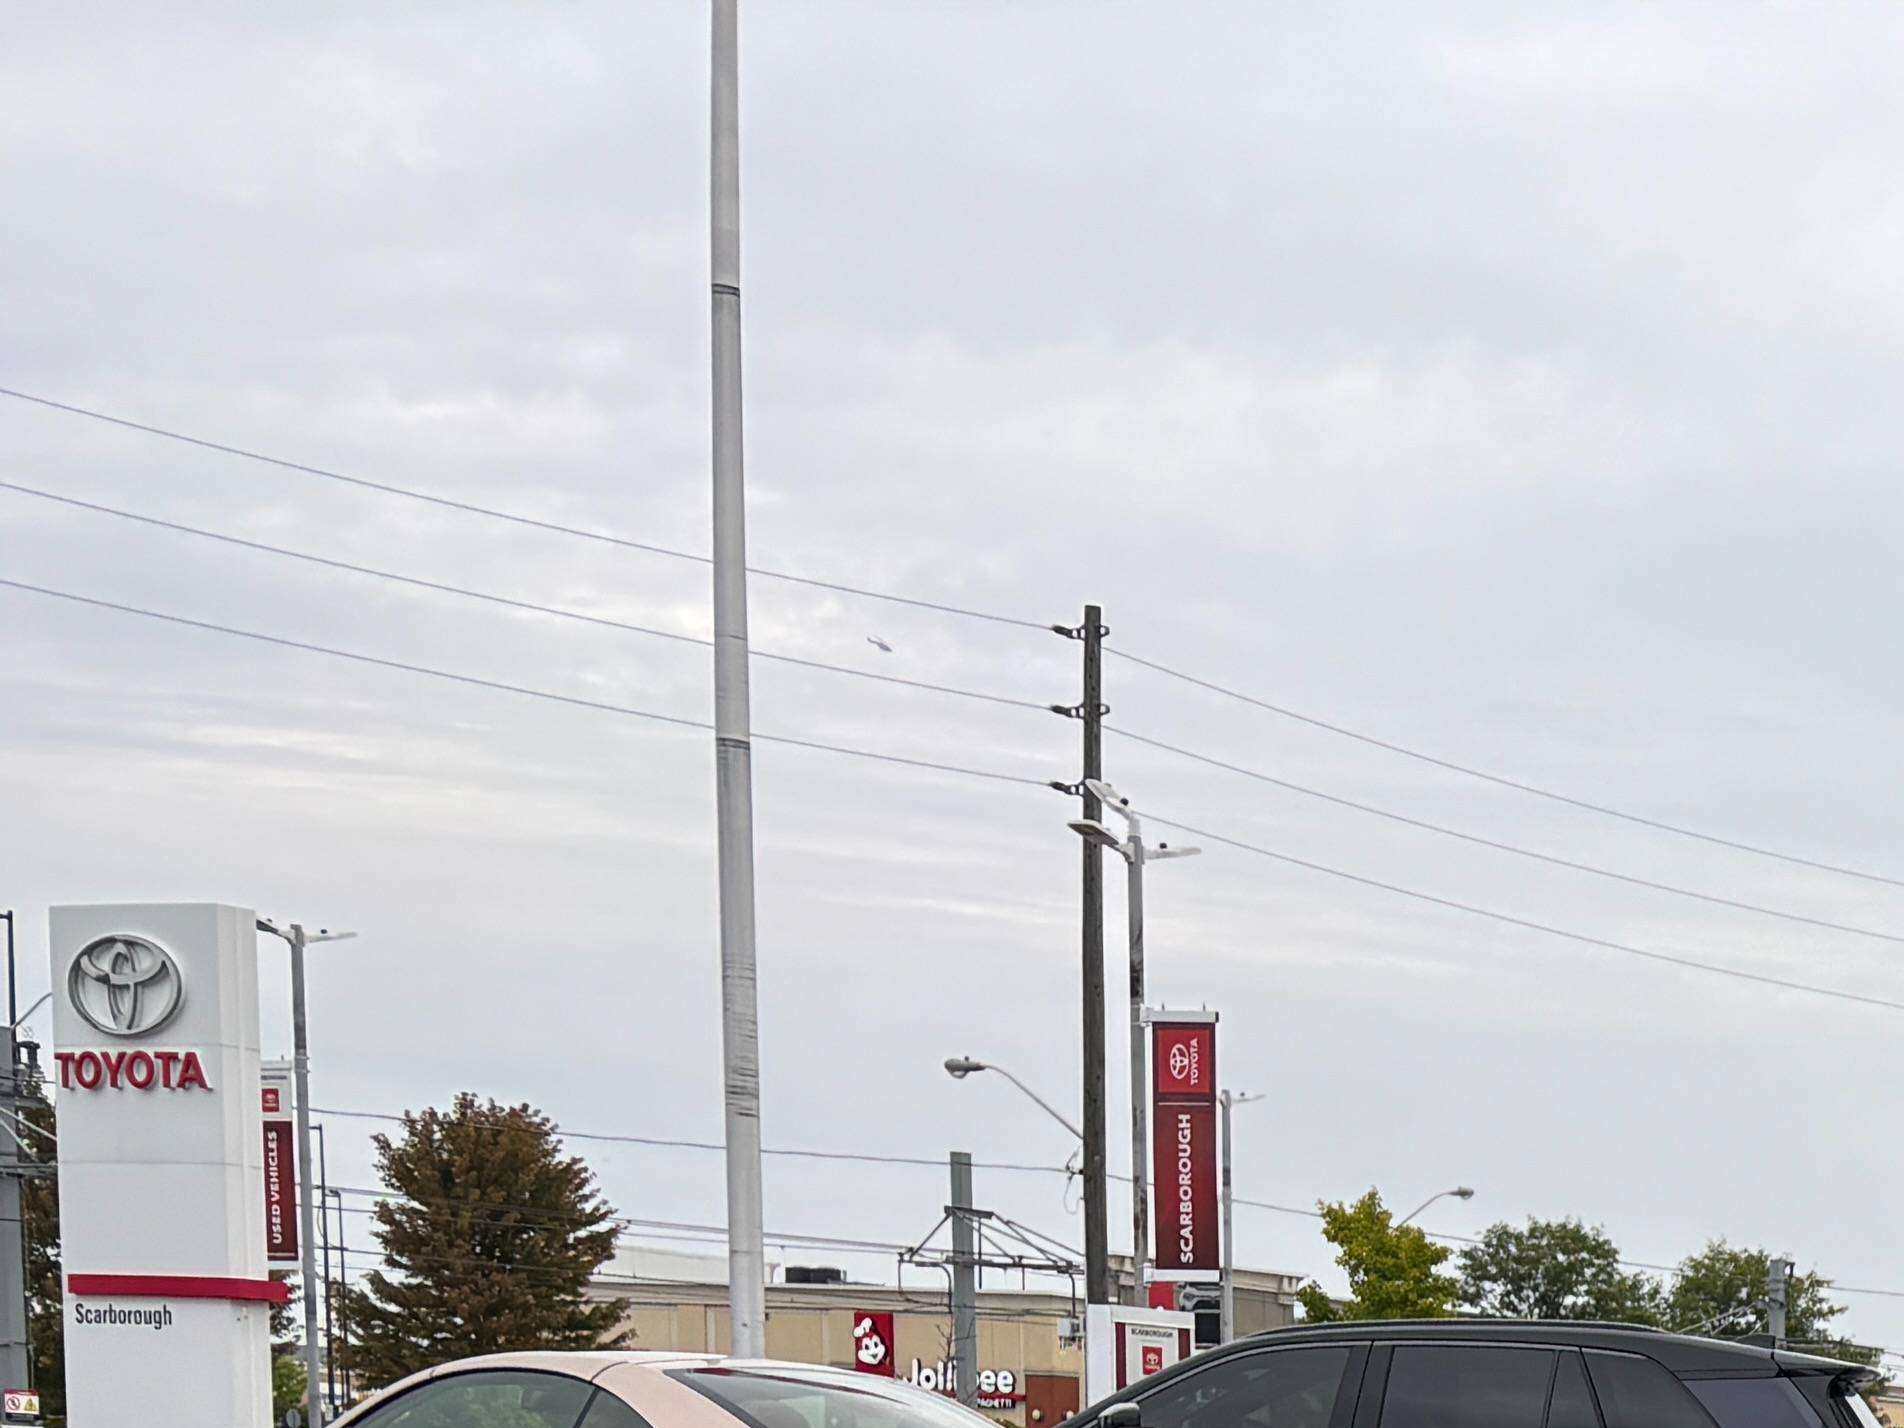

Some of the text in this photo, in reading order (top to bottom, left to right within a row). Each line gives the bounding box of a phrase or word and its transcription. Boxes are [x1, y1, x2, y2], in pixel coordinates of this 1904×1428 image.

[54, 1051, 210, 1090] TOYOTA
[1190, 1037, 1199, 1086] TOYOTA
[267, 1130, 283, 1244] USED VEHICLES
[1178, 1113, 1194, 1264] SCARBOROUGH
[75, 1303, 172, 1330] Scarborough
